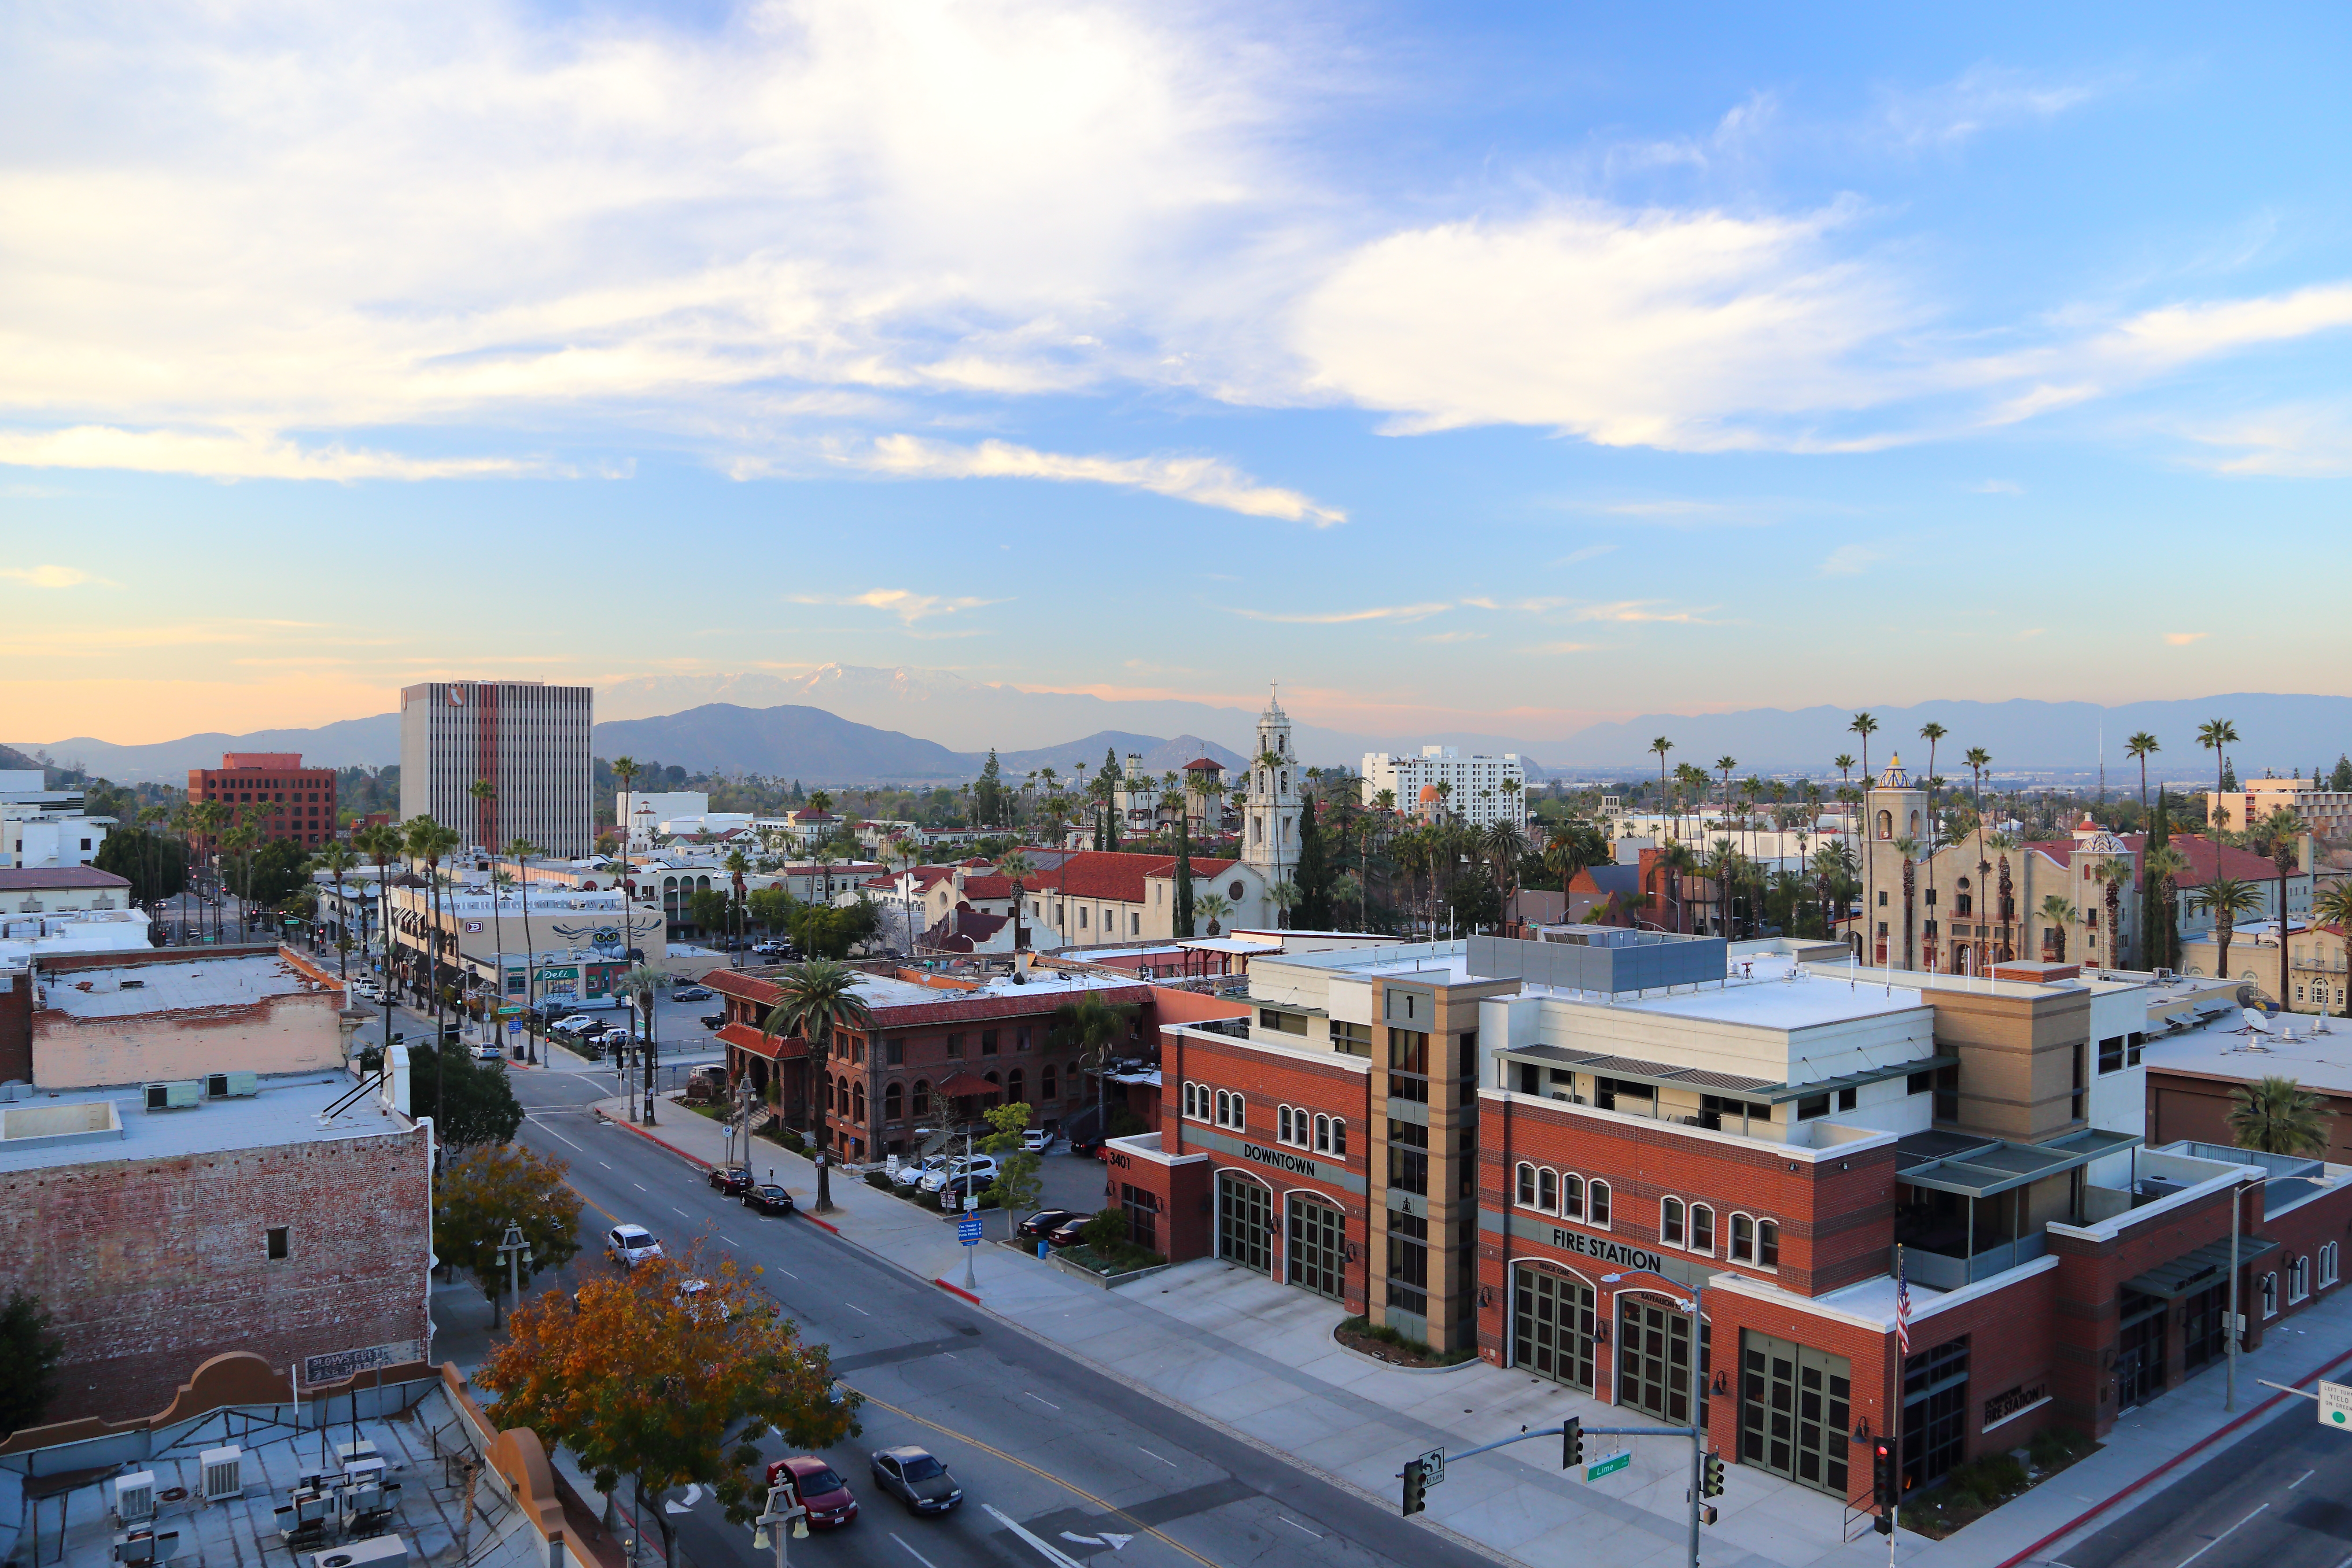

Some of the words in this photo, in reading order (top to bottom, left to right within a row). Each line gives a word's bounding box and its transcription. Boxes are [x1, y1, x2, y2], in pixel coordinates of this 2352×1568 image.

[545, 970, 570, 978] Deli
[1406, 996, 1413, 1018] 1
[1110, 1152, 1130, 1170] 3401
[1244, 1144, 1315, 1177] DOWNTOWN
[1305, 1193, 1321, 1202] ENGINE
[1553, 1229, 1585, 1253] FIRE
[1589, 1239, 1660, 1273] STATION
[1539, 1262, 1556, 1272] TRUCK
[1557, 1268, 1570, 1277] ONE
[1641, 1292, 1674, 1308] BATTALION
[1985, 1385, 2022, 1409] DOWNTOWN
[1985, 1405, 2002, 1425] FIRE
[2004, 1386, 2039, 1415] STATION
[2330, 1394, 2348, 1403] YIELD
[1597, 1464, 1613, 1476] Lime
